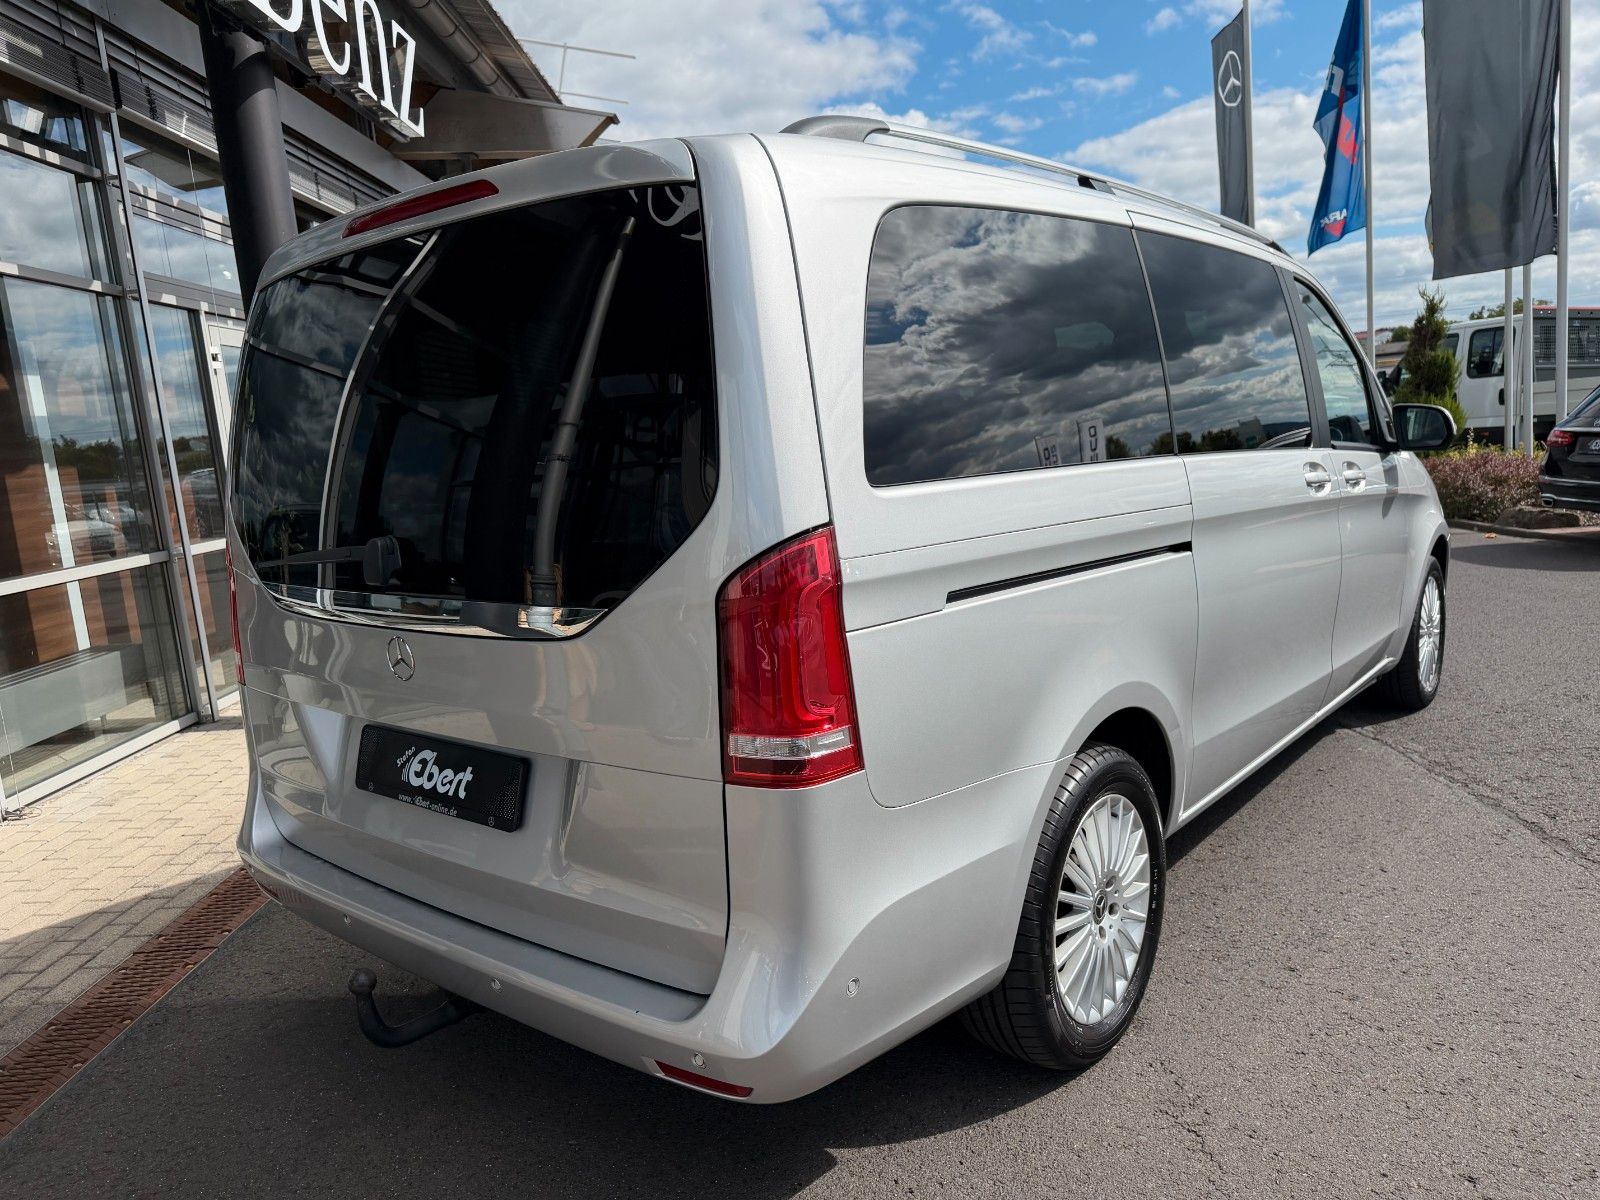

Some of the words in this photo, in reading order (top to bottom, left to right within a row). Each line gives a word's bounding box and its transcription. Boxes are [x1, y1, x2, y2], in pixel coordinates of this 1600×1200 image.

[248, 0, 425, 138] enz
[396, 746, 416, 768] Stefan
[408, 749, 474, 800] Ebert
